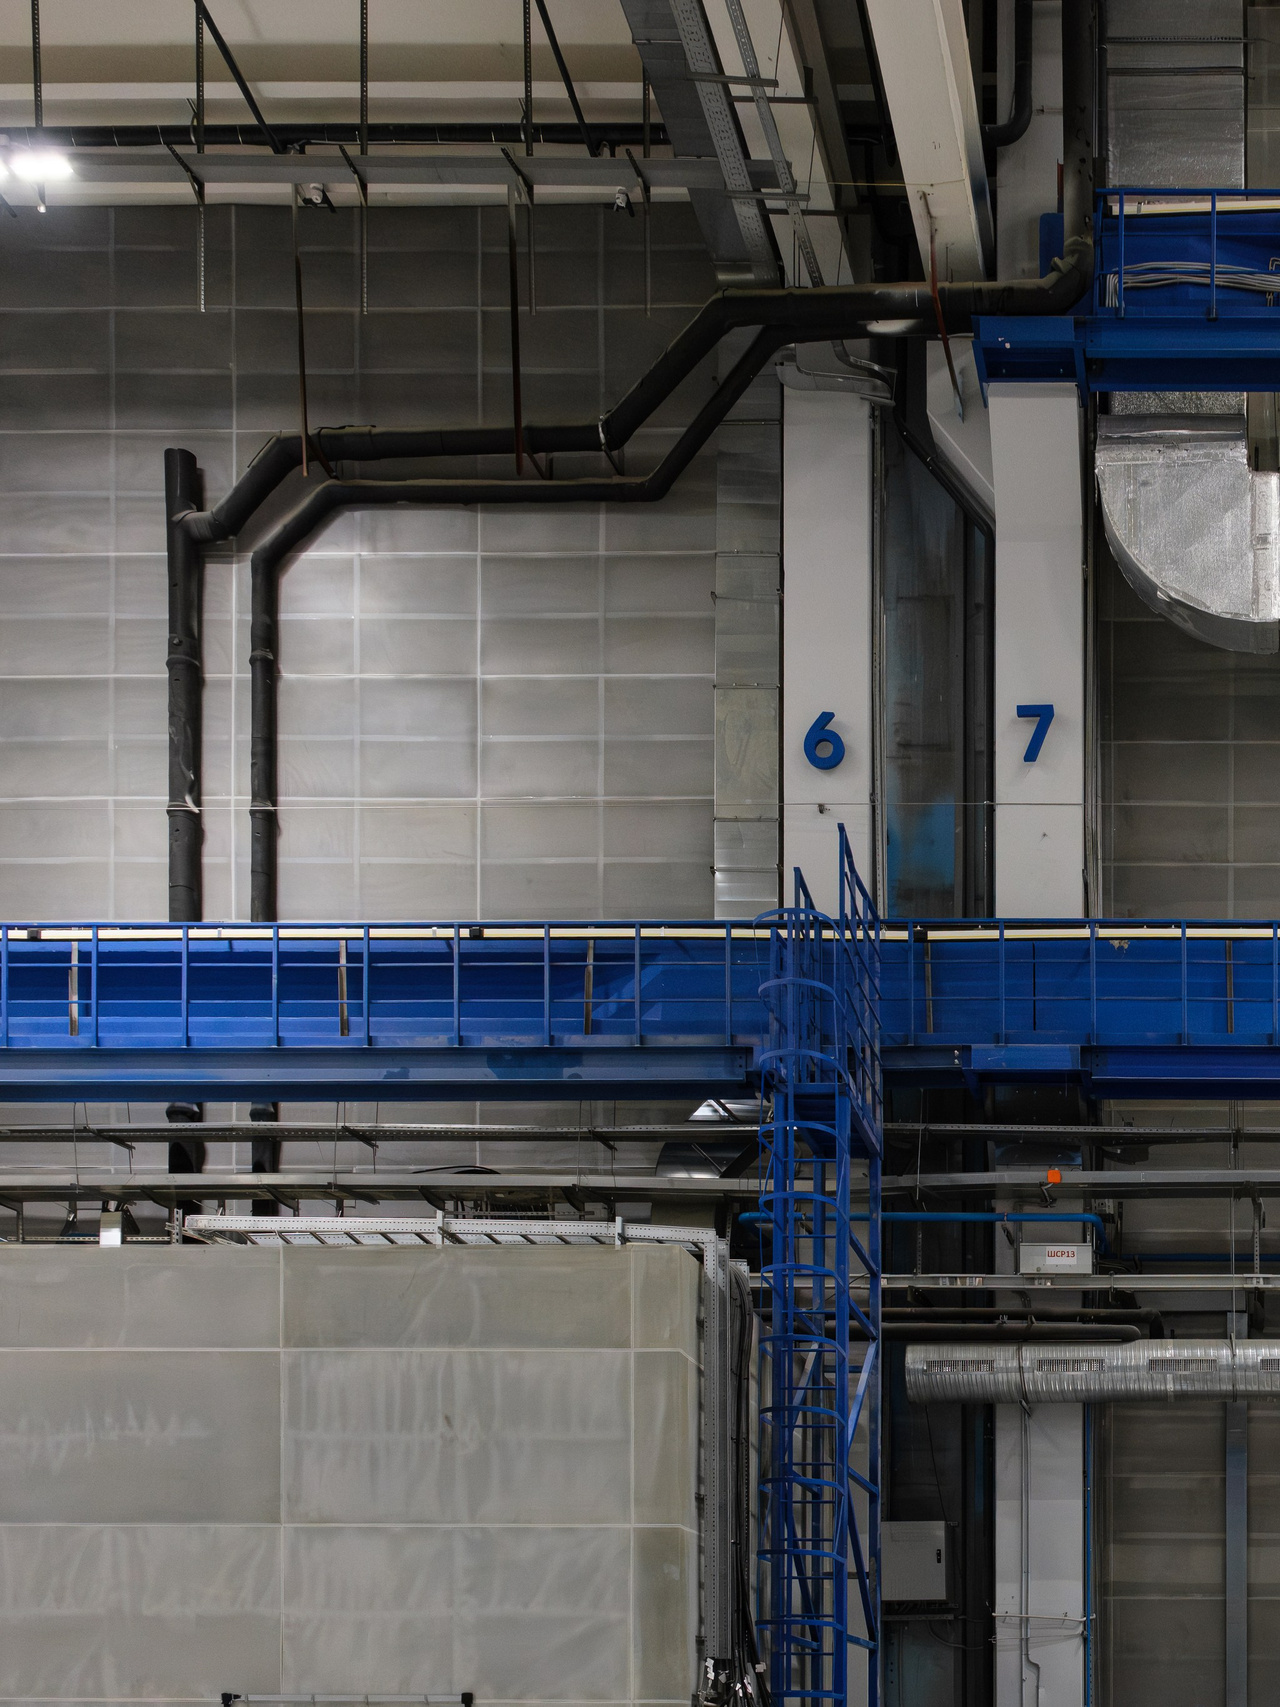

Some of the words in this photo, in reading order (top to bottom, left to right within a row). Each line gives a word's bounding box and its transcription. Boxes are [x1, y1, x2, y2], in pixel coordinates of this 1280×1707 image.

[804, 711, 845, 770] 6
[1017, 705, 1054, 762] 7
[1047, 1250, 1076, 1258] ШСР13
